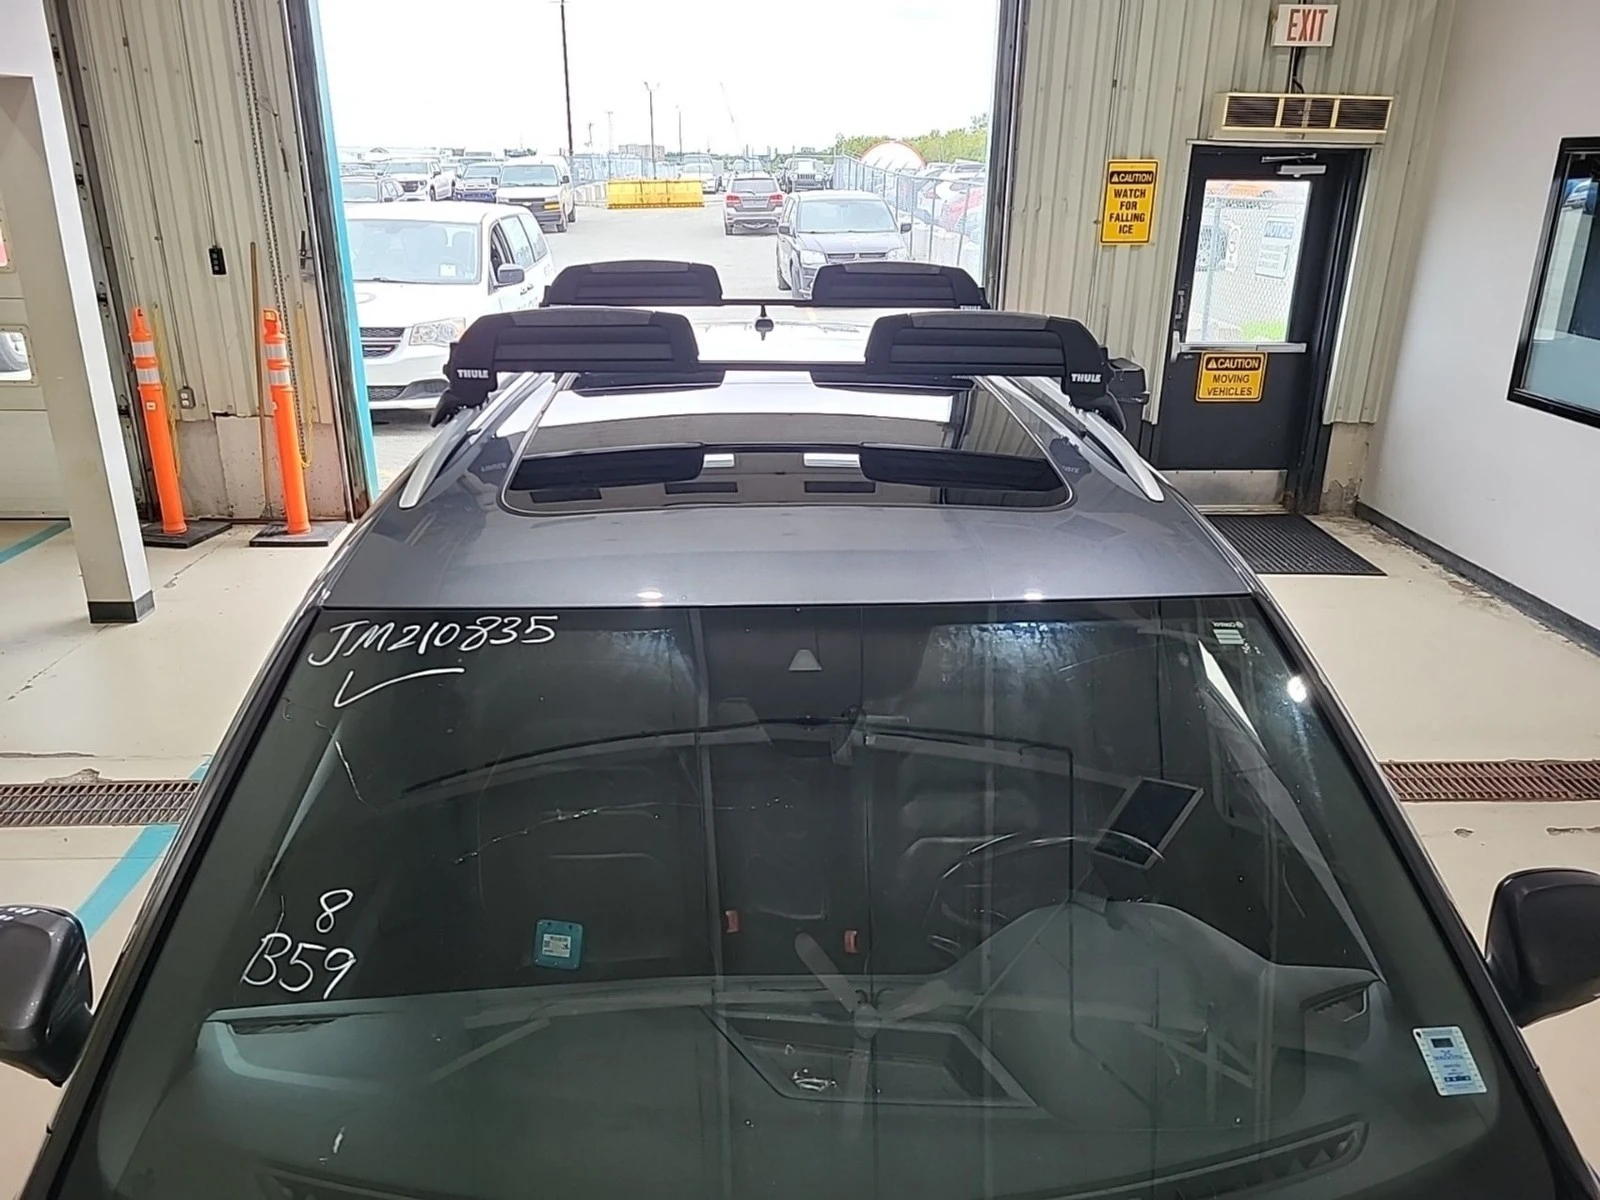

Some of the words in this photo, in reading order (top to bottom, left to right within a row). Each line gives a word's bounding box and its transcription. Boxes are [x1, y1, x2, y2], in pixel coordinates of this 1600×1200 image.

[1286, 8, 1328, 41] EXIT
[1119, 172, 1153, 183] CAUTION
[1114, 188, 1146, 199] WATCH
[1119, 200, 1138, 211] FOR
[1109, 212, 1145, 222] FALLING
[1118, 224, 1134, 234] ICE
[1217, 358, 1259, 369] CAUTION
[456, 369, 489, 379] THULE
[1071, 373, 1102, 383] THULE
[1212, 374, 1250, 384] MOVING
[1207, 387, 1253, 396] VEHICLES
[308, 615, 559, 666] JM210835
[316, 888, 354, 933] 8
[240, 932, 357, 1000] B59
